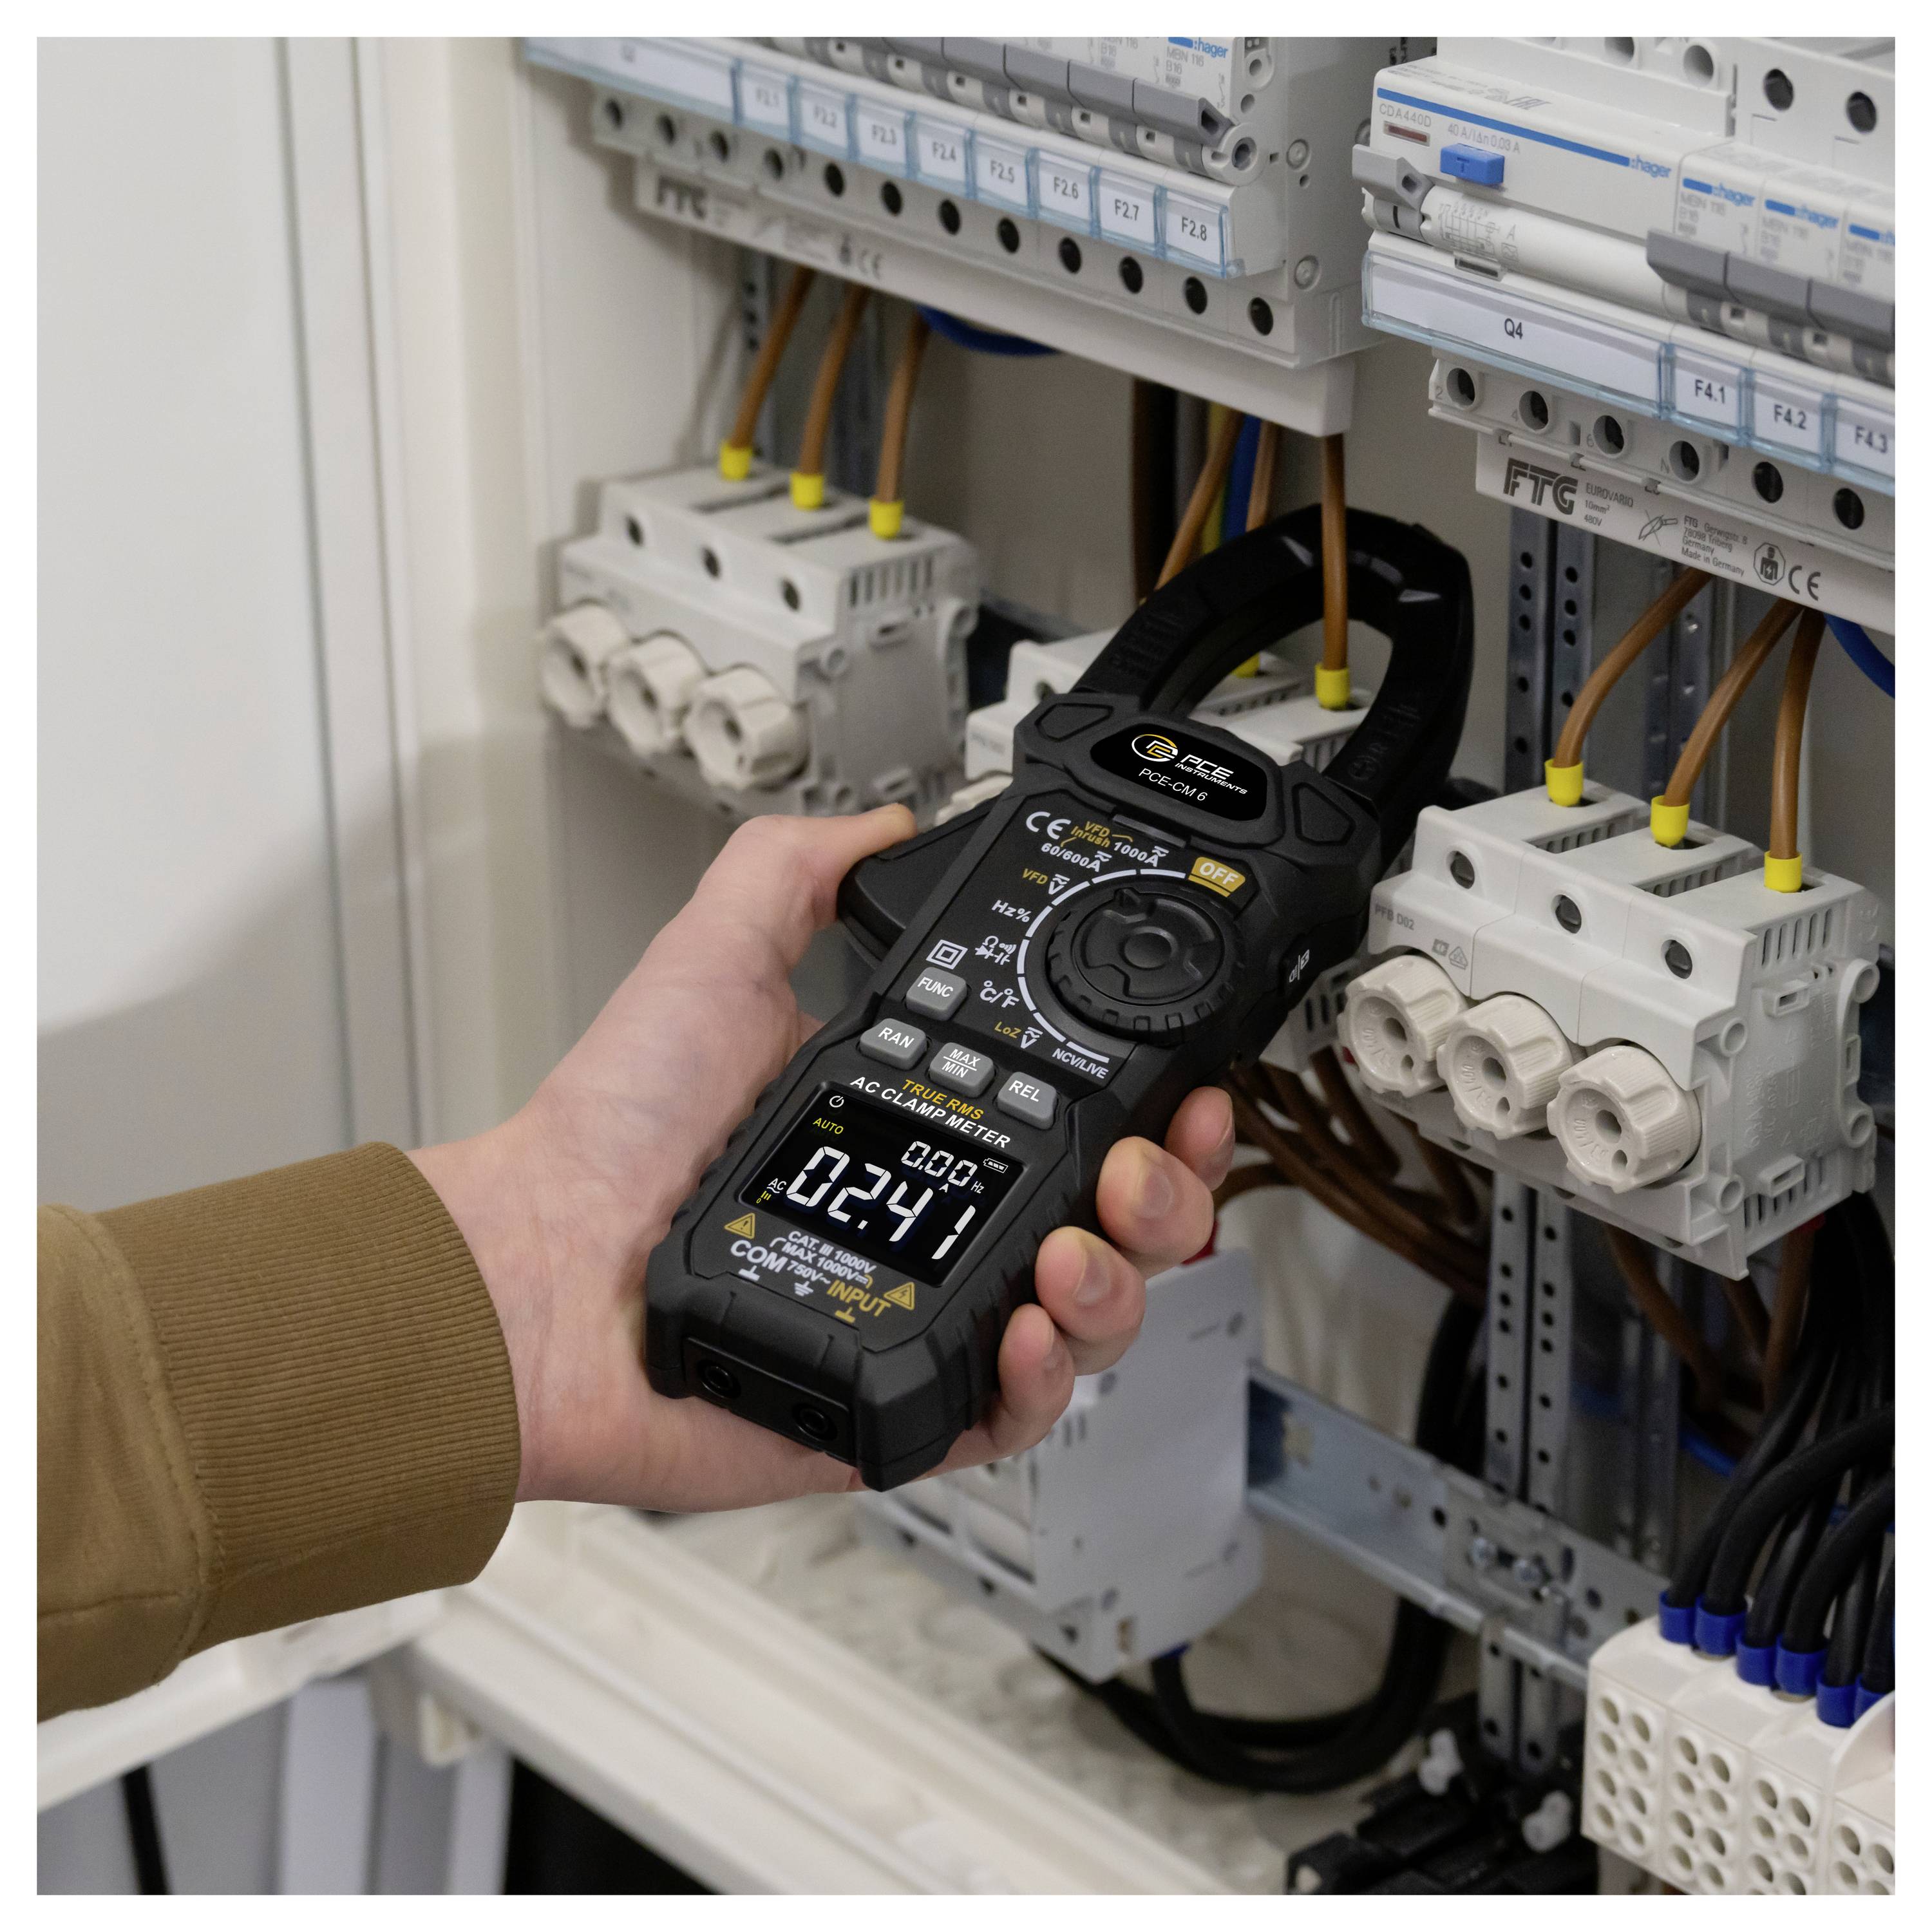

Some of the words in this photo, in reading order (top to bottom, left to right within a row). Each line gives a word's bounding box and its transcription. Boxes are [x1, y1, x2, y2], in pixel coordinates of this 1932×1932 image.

[871, 124, 897, 145] F2.3
[933, 141, 957, 162] F2.4
[990, 160, 1015, 184] F2.5
[1053, 176, 1079, 199] F2.6
[1114, 198, 1140, 221] F2.7
[1181, 216, 1208, 242] F2.8
[1504, 317, 1524, 340] Q4
[1435, 386, 1443, 400] 2
[1694, 379, 1726, 405] F4.1
[1774, 404, 1807, 430] F4.2
[1854, 425, 1888, 453] F4.3
[1503, 457, 1578, 515] FTG
[1586, 482, 1634, 507] EUROVARIO
[1584, 514, 1602, 527] 480V
[1684, 515, 1698, 528] FTG
[1742, 535, 1748, 545] 8
[1682, 535, 1714, 556] Germany
[1681, 546, 1701, 561] Made
[1703, 553, 1710, 564] in
[1712, 556, 1745, 577] Germany
[1175, 762, 1248, 795] INSTRUMENTS
[1180, 754, 1234, 780] PCE
[1139, 768, 1197, 797] PCE-CM
[1197, 791, 1208, 802] 6
[1070, 826, 1111, 848] Inrush
[1084, 820, 1110, 838] VFD
[1041, 842, 1103, 872] 60/600A
[1113, 841, 1160, 867] 1000A
[1021, 867, 1048, 886] VFD
[1199, 861, 1238, 886] OFF
[991, 899, 1032, 923] Hz%
[1374, 904, 1394, 922] PFB
[917, 976, 954, 998] FUNC
[878, 1027, 914, 1048] RAN
[994, 1021, 1022, 1039] LoZ
[942, 1061, 969, 1079] MIN
[949, 1048, 981, 1068] MAX
[1052, 1047, 1109, 1079] NCV/LIVE
[901, 1079, 948, 1105] TRUE
[945, 1097, 985, 1120] RMS
[1008, 1079, 1041, 1103] REL
[849, 1075, 880, 1094] AC
[880, 1087, 947, 1119] CLAMP
[945, 1113, 1011, 1149] METER
[813, 1117, 845, 1135] AUTO
[901, 1141, 978, 1187] 0.00
[971, 1180, 985, 1194] Hz
[768, 1178, 786, 1191] AC
[786, 1146, 976, 1260] 02.41
[730, 1239, 789, 1273] COM
[781, 1242, 814, 1264] MAX
[788, 1231, 820, 1250] CAT.
[835, 1249, 877, 1274] 1000V
[826, 1279, 891, 1318] INPUT
